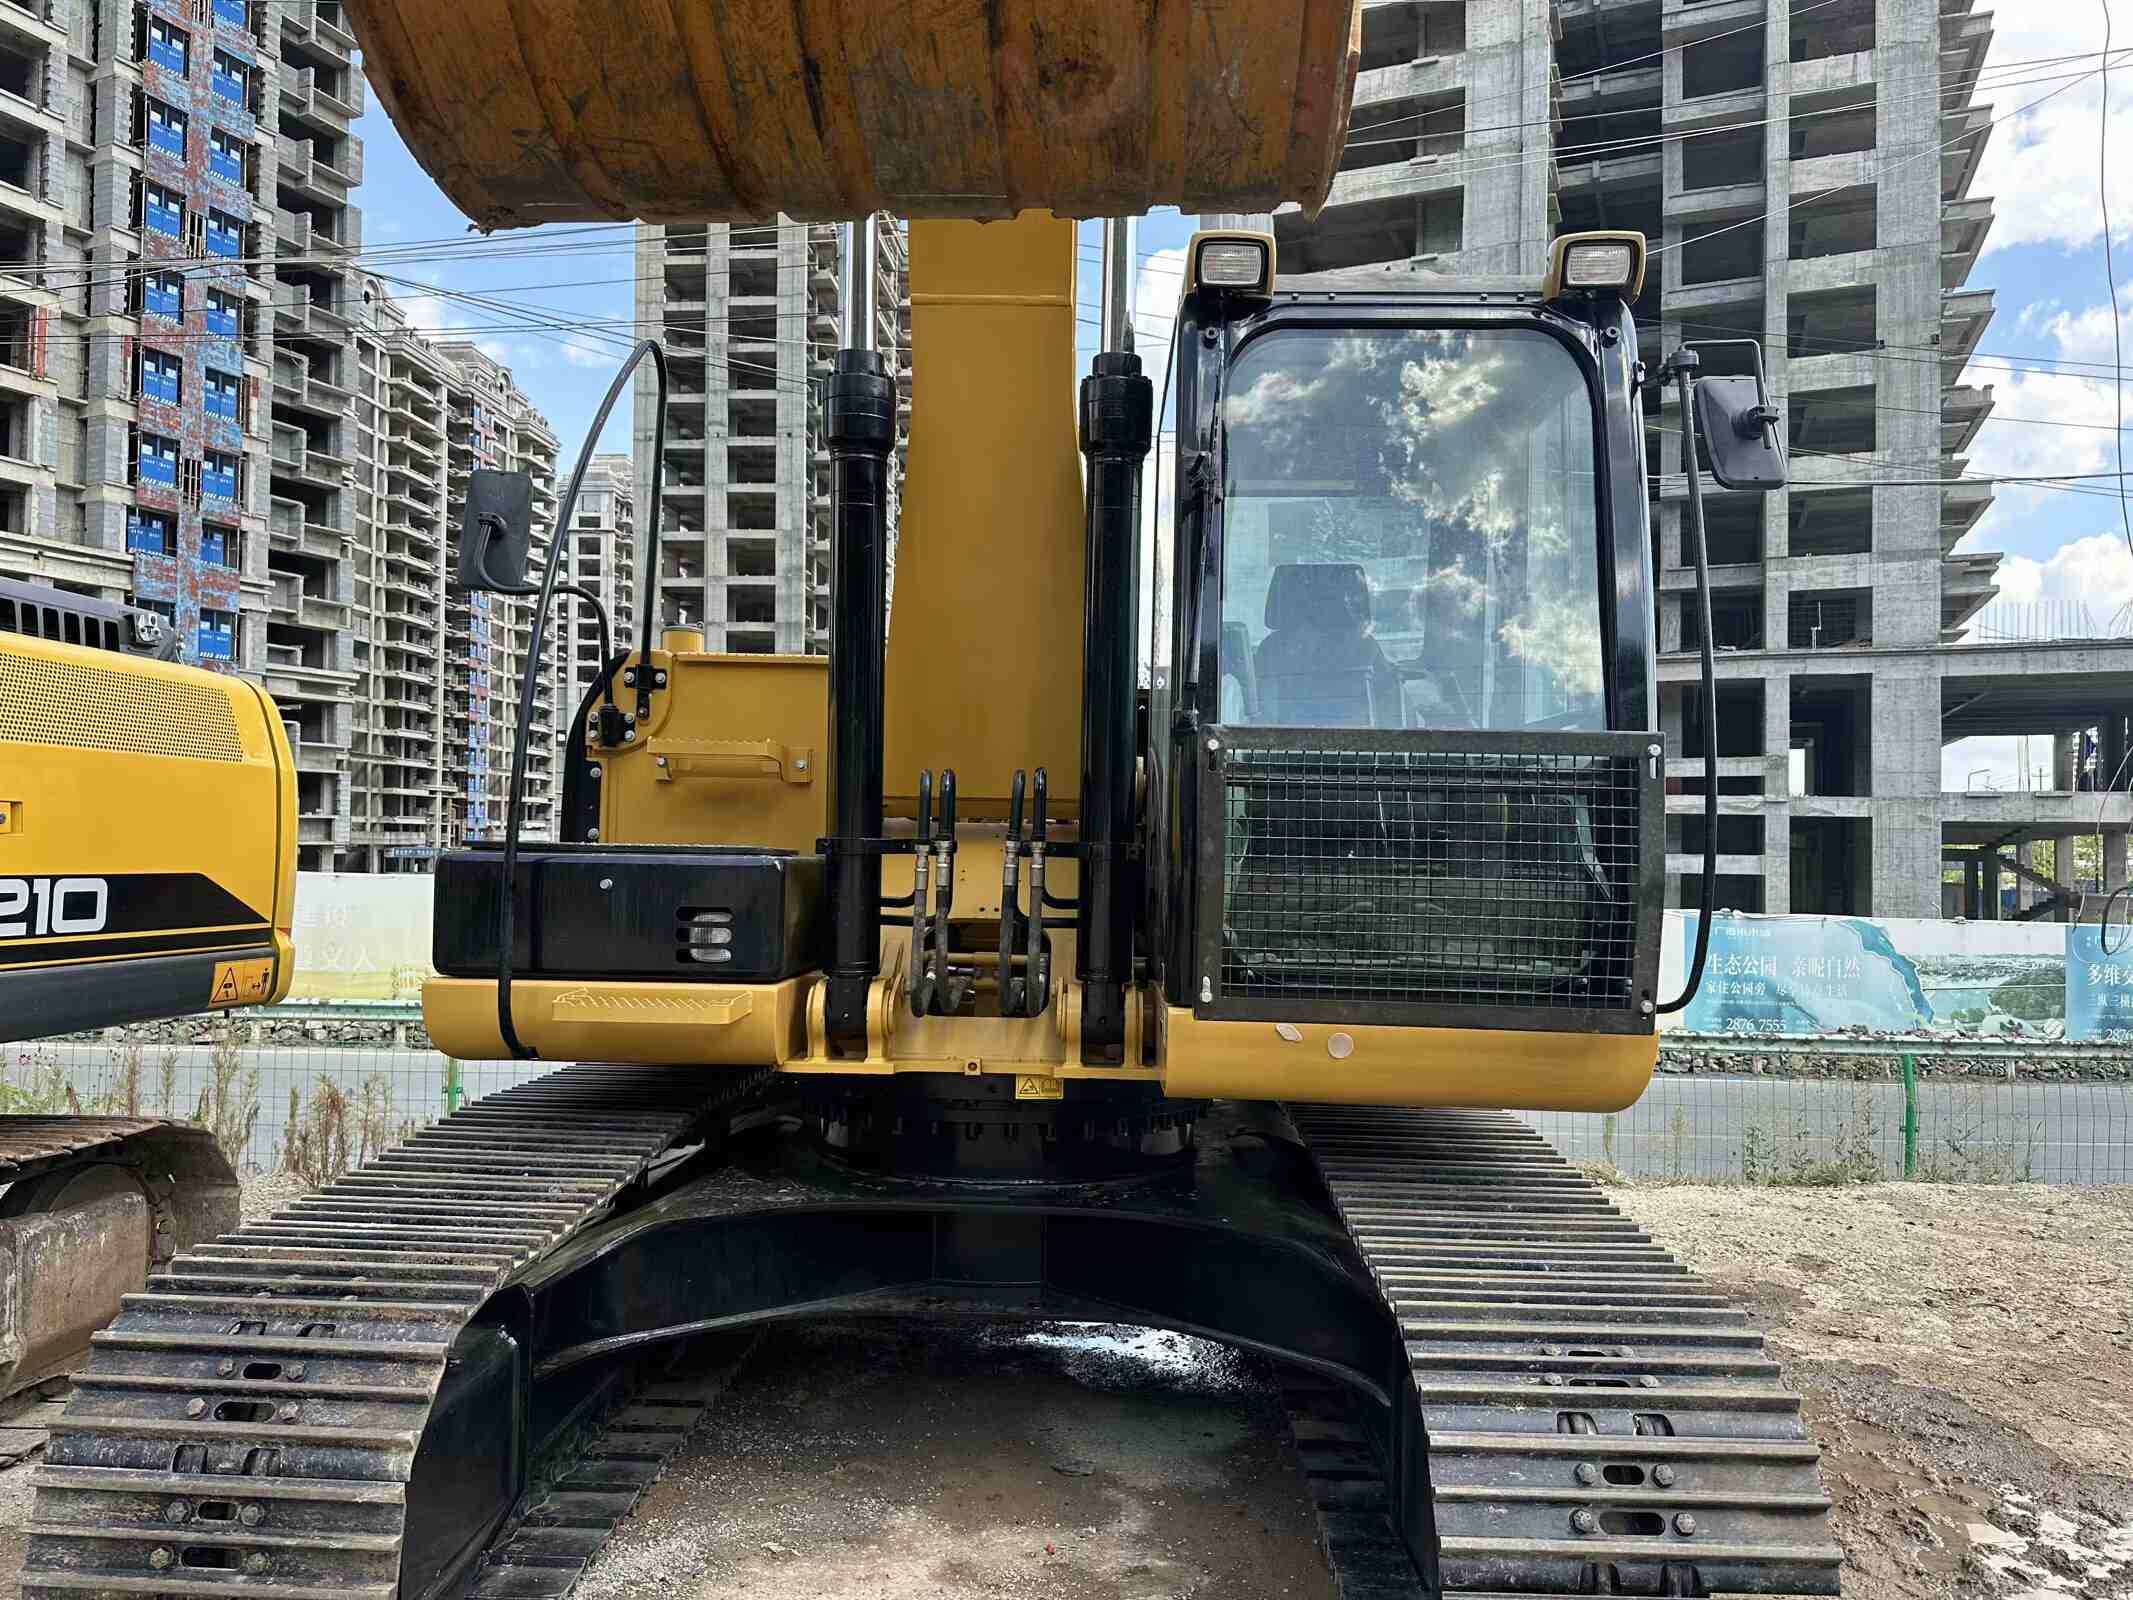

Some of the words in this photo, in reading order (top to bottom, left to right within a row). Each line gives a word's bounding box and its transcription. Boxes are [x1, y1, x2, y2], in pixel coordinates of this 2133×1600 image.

[0, 877, 108, 937] 210
[1706, 952, 1776, 977] 生态公园
[1726, 1017, 1755, 1031] 2876
